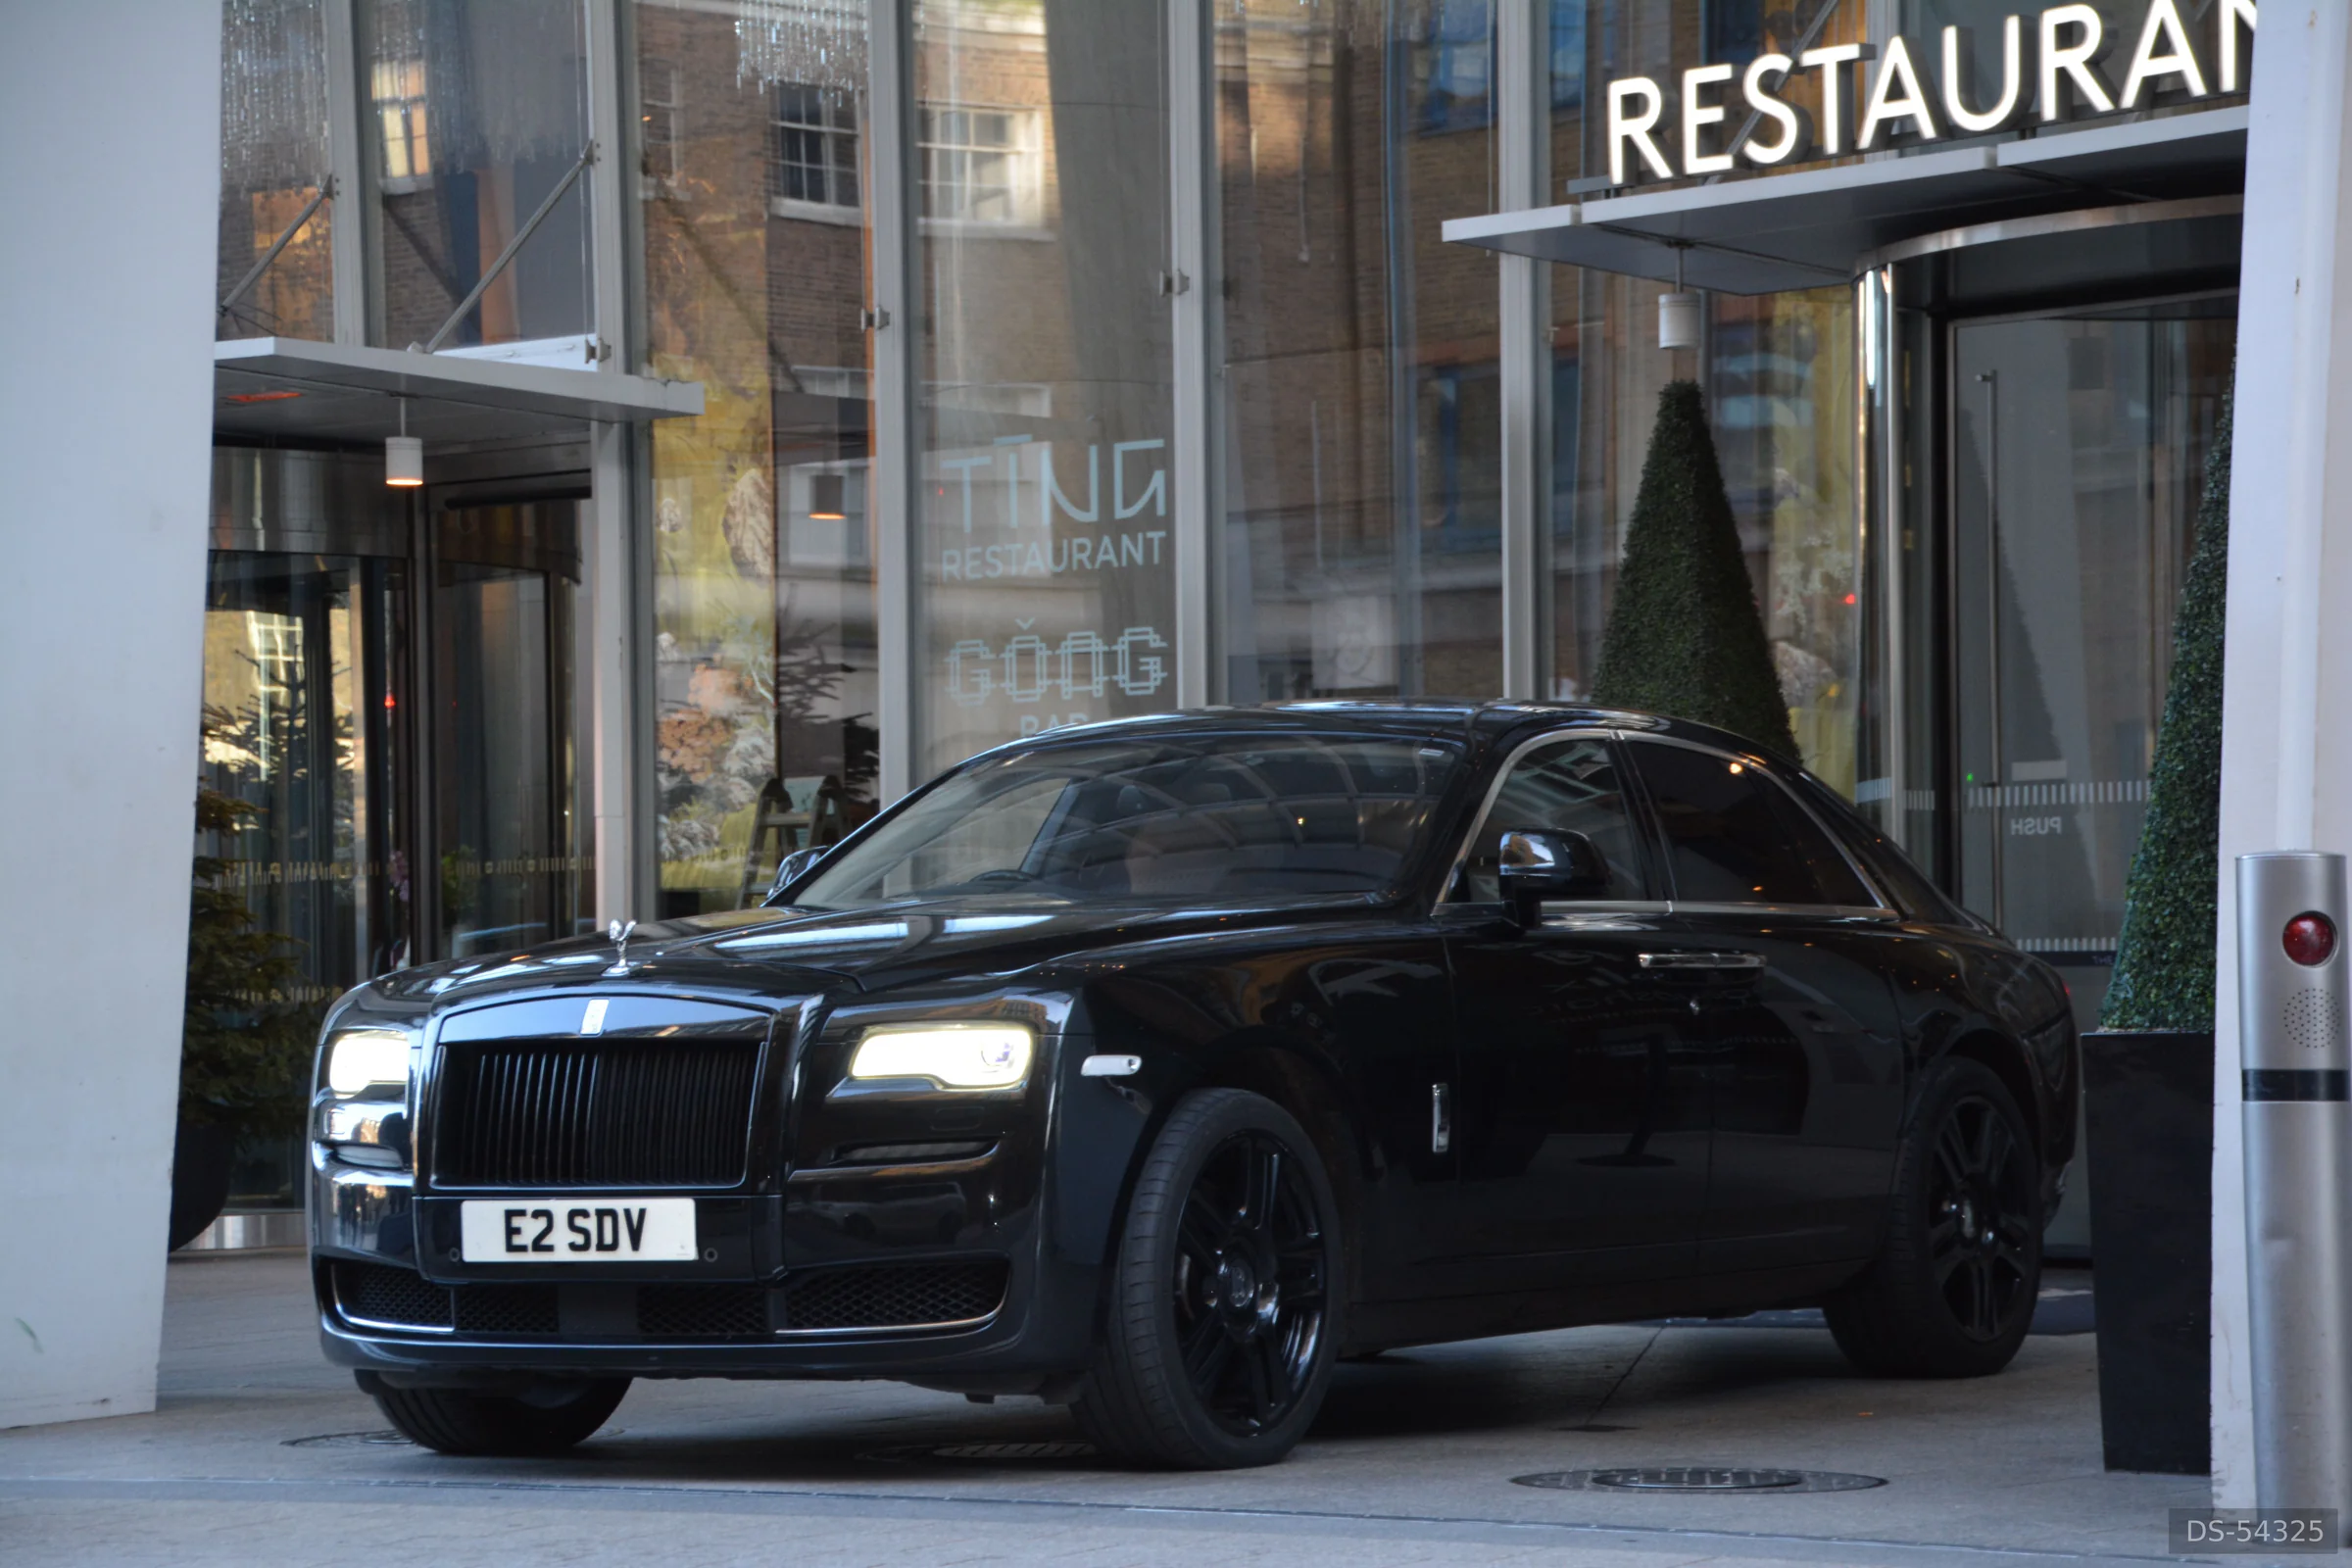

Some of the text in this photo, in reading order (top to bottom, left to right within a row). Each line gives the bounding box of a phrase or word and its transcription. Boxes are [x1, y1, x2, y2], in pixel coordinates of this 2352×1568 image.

[942, 531, 1166, 582] RESTAURANT
[504, 1207, 647, 1252] E2 SDV
